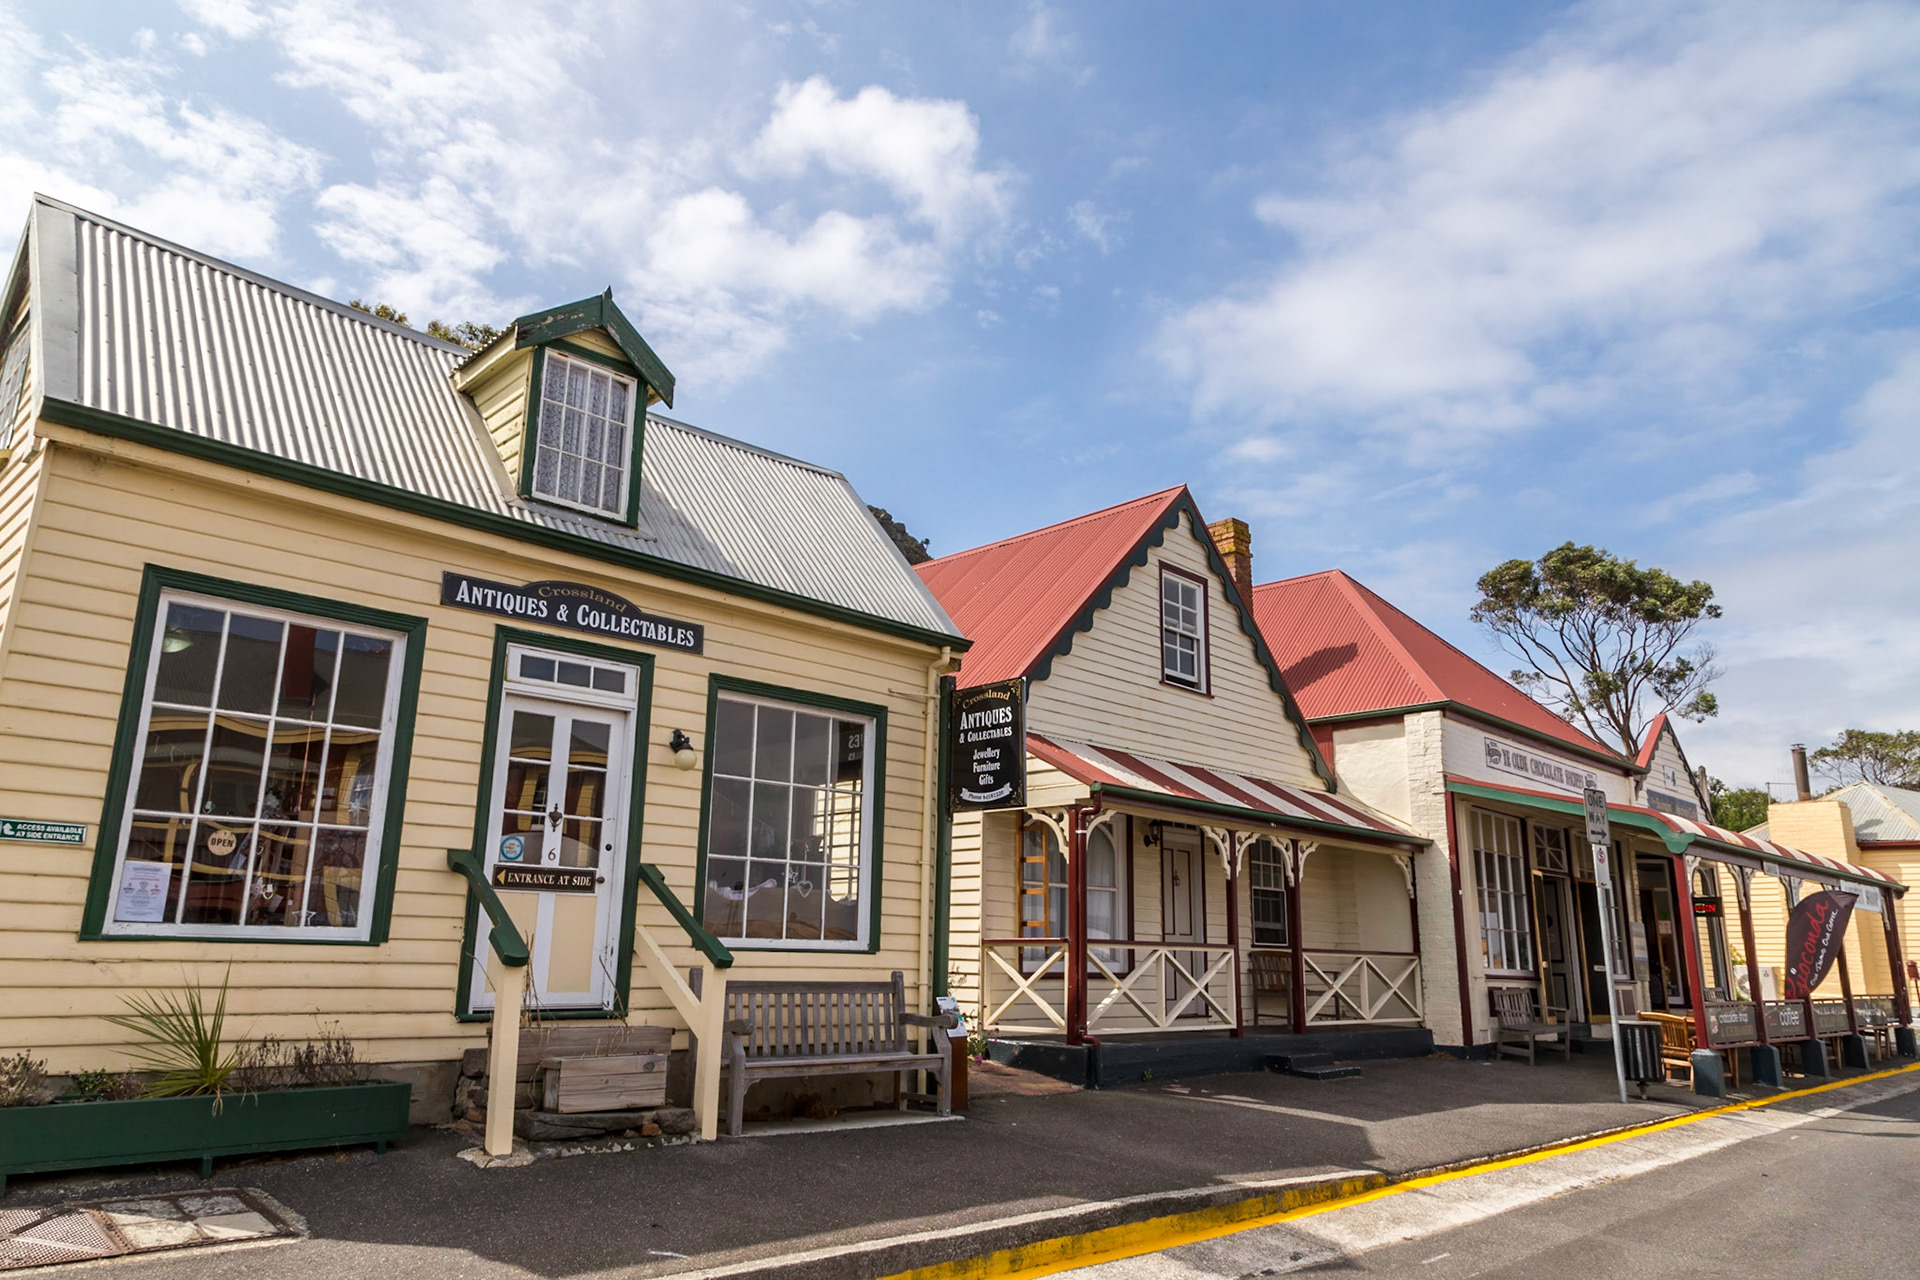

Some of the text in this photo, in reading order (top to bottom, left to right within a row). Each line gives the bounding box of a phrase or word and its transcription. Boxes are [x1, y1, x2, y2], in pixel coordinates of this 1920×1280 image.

[538, 586, 626, 613] Crossland
[456, 580, 695, 647] ANTIQUES & COLLECTABLES
[962, 689, 1010, 709] Crossland
[960, 706, 1013, 730] ANTIQUES
[959, 726, 1012, 743] & COLLECTABLES
[973, 747, 1000, 760] Jewellery
[973, 761, 1000, 773] Furniture
[1502, 749, 1511, 767] YE
[1512, 753, 1529, 772] OLDE
[1530, 758, 1564, 783] CHOCOLATE
[979, 774, 994, 785] Gifts
[968, 793, 982, 801] Phone
[1588, 794, 1604, 808] ONE
[1588, 811, 1605, 824] WAY
[17, 823, 83, 834] ACCESS AVAILABLE
[43, 833, 81, 841] ENTRANCE
[211, 838, 233, 848] OPEN
[548, 847, 556, 861] 6
[507, 872, 592, 886] ENTRANCE AT SIDE
